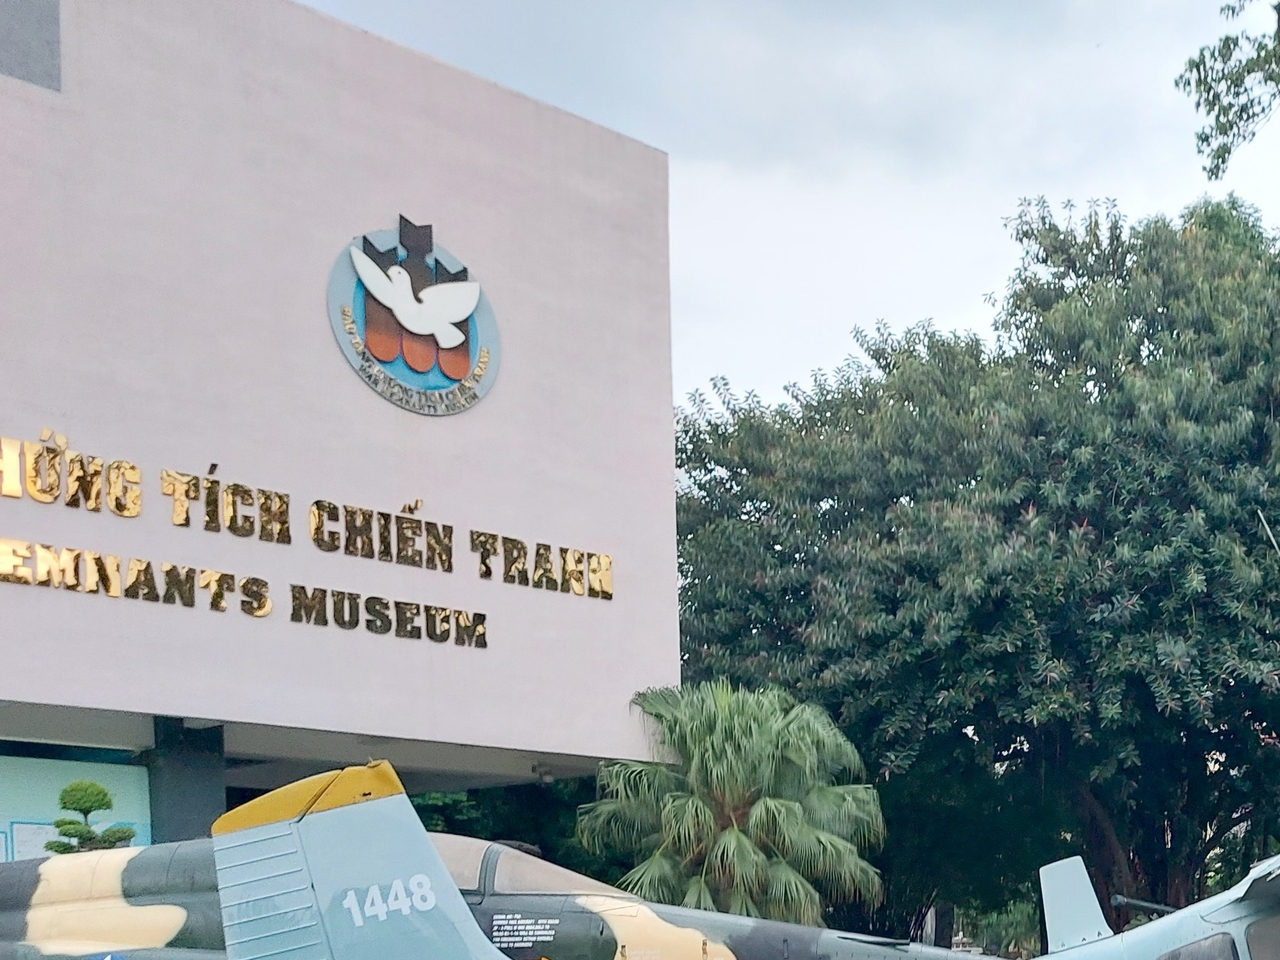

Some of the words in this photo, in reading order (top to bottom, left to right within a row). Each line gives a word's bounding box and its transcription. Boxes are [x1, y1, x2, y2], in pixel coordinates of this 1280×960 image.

[160, 463, 292, 545] TÍCH
[309, 498, 454, 573] CHIẾN
[469, 529, 614, 600] TRANH
[289, 583, 488, 649] MUSEUM
[342, 873, 436, 927] 1448
